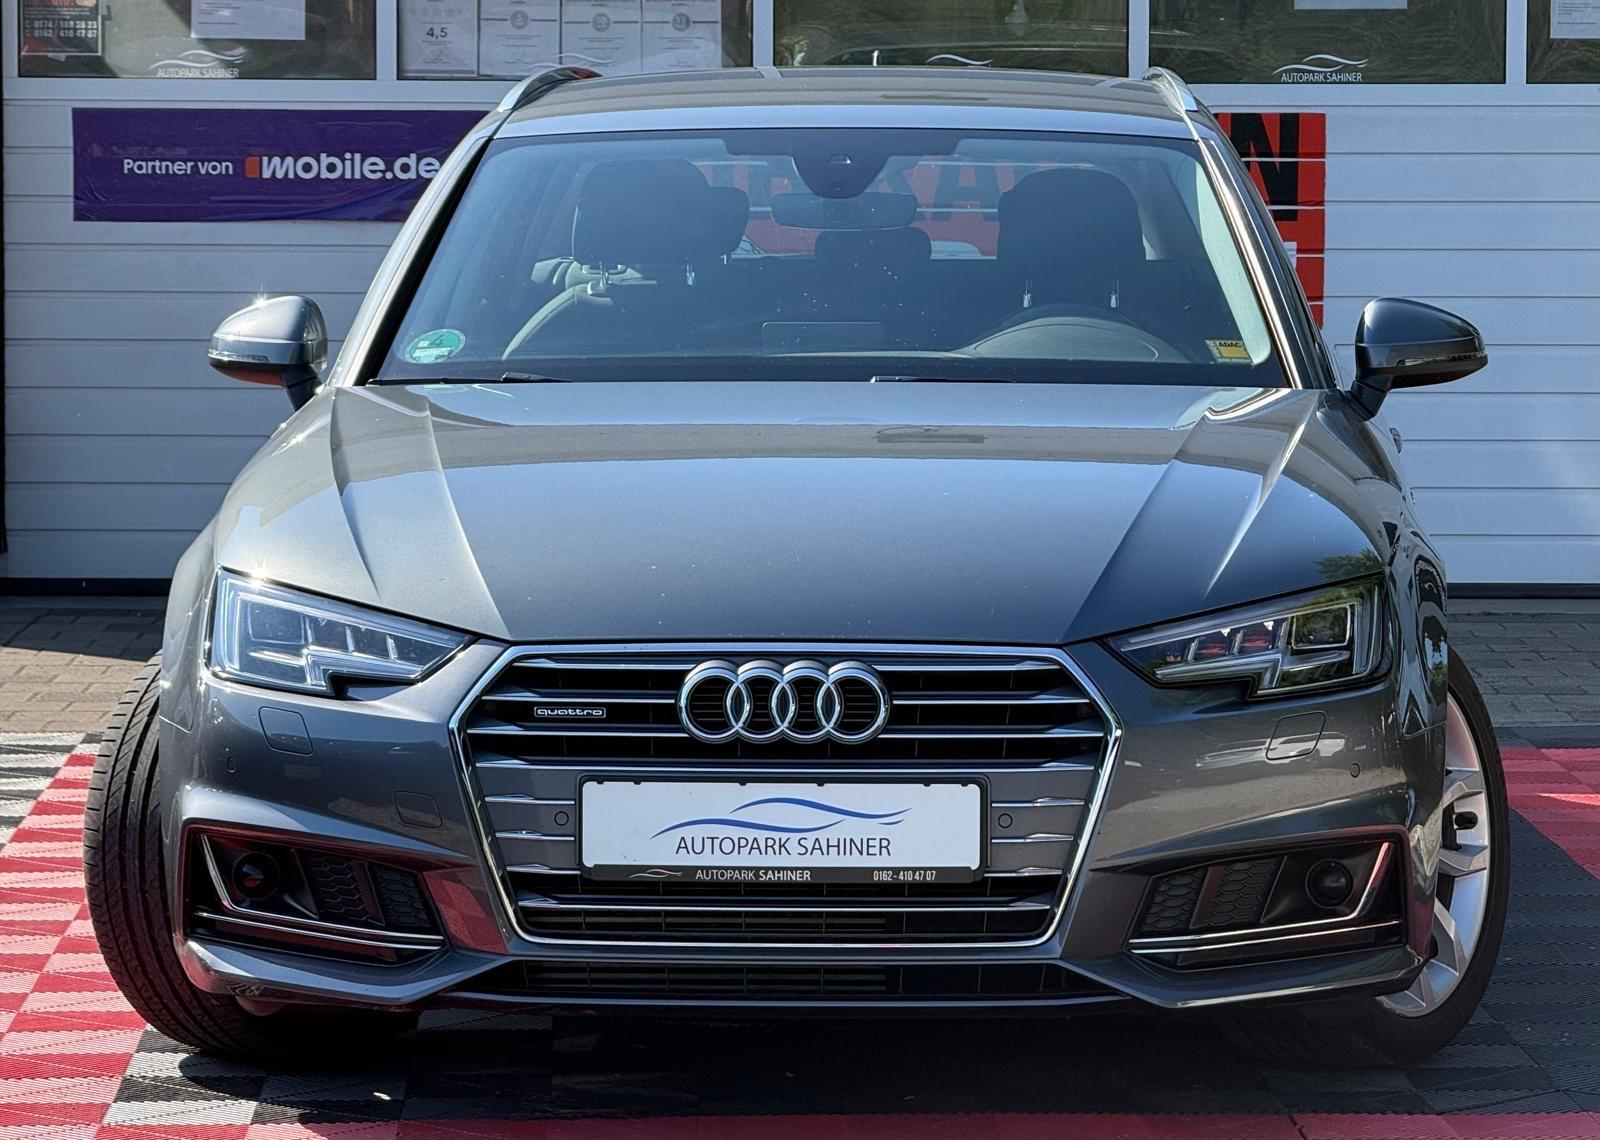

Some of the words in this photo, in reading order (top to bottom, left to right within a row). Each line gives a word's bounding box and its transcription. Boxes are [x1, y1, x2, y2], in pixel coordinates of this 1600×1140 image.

[426, 27, 448, 39] 4,5
[157, 67, 200, 78] AUTOPARK
[202, 67, 240, 78] SAHINER
[1281, 73, 1325, 82] AUTOPARK
[1327, 73, 1362, 82] SAHINER
[123, 159, 193, 175] Partner
[197, 162, 233, 175] von
[261, 153, 441, 180] mobile.de
[537, 708, 602, 716] quattro
[675, 836, 791, 857] AUTOPARK
[797, 836, 891, 857] SAHINER
[695, 870, 756, 881] AUTOPARK
[759, 870, 811, 881] SAHINER
